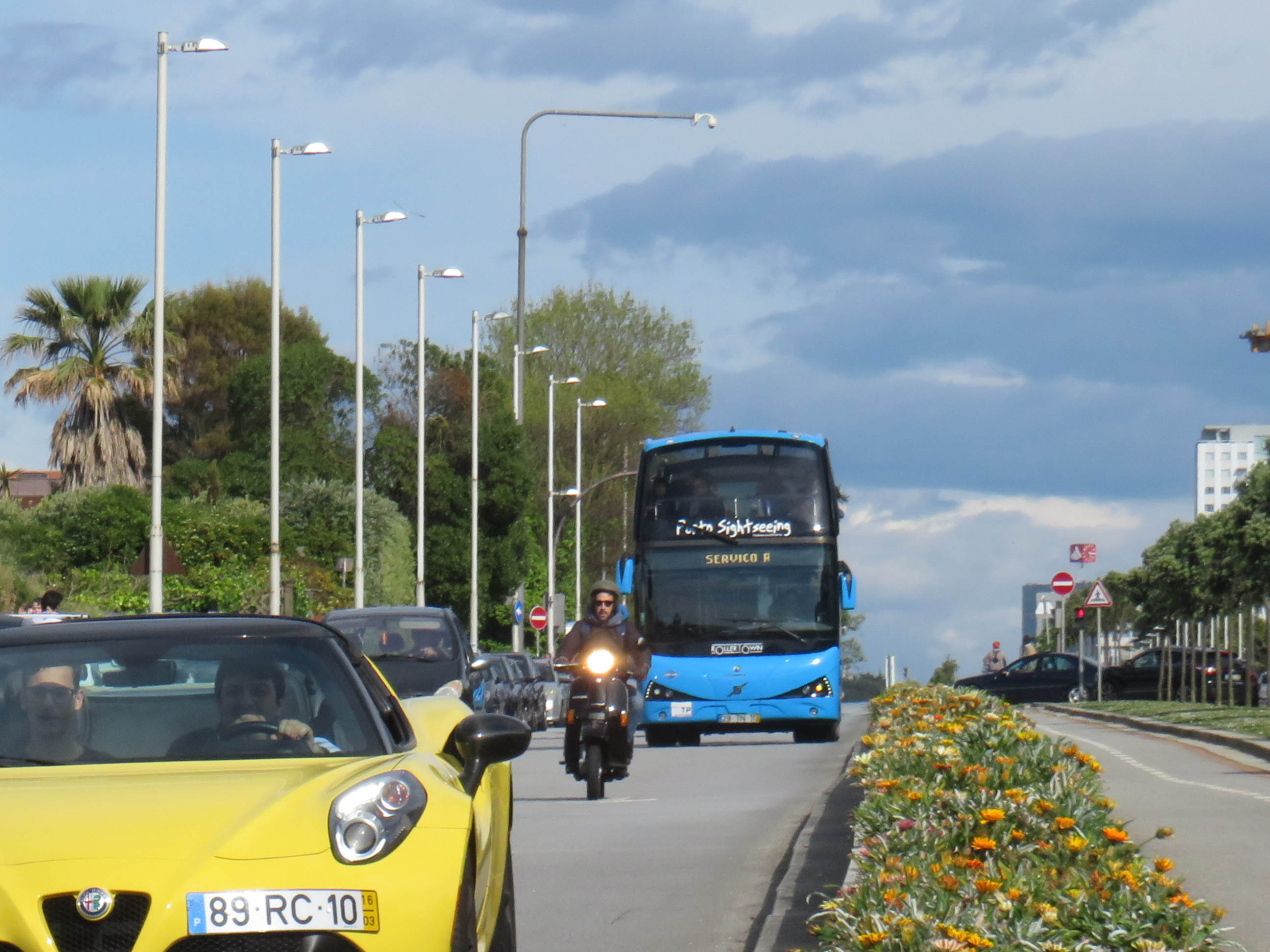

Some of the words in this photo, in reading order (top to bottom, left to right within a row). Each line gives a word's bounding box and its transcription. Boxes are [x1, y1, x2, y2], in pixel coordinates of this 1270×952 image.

[717, 518, 792, 538] Sightseeing
[362, 895, 373, 905] 16
[193, 917, 201, 926] P
[363, 915, 375, 926] 03
